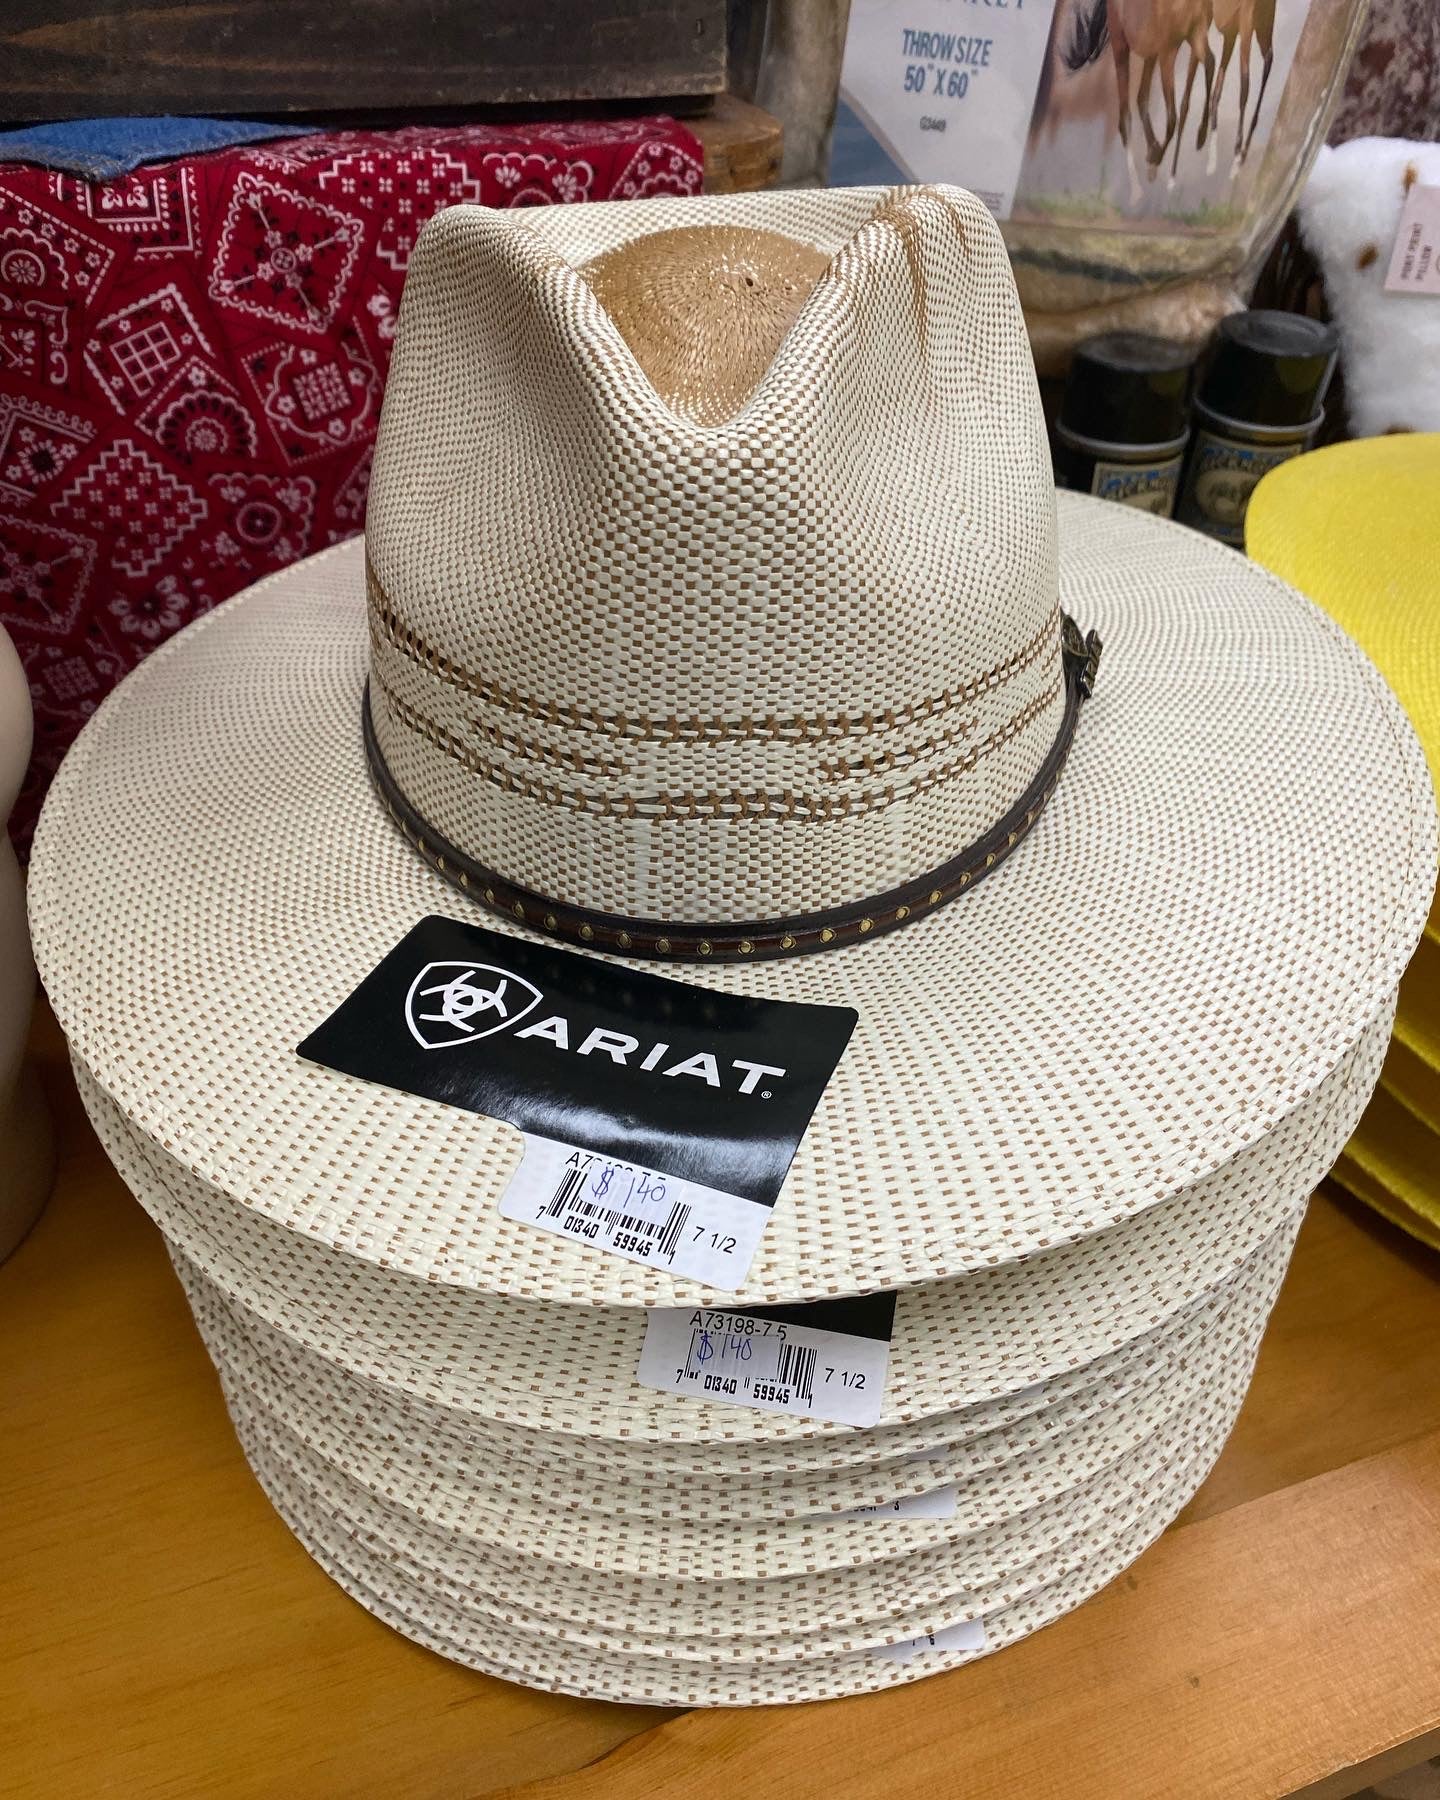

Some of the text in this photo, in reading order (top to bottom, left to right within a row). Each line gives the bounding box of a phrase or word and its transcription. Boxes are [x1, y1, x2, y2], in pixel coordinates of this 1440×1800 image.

[903, 28, 993, 66] THROW SIZE
[934, 69, 947, 96] X
[514, 1015, 787, 1095] ARIAT
[535, 1205, 546, 1220] 7
[563, 1215, 600, 1239] 01340
[613, 1232, 653, 1257] 59945
[692, 1226, 737, 1254] 7 1/2
[675, 1368, 684, 1384] 7
[703, 1374, 738, 1396] 01340
[752, 1384, 790, 1405] 59945
[825, 1367, 866, 1390] 7 1/2
